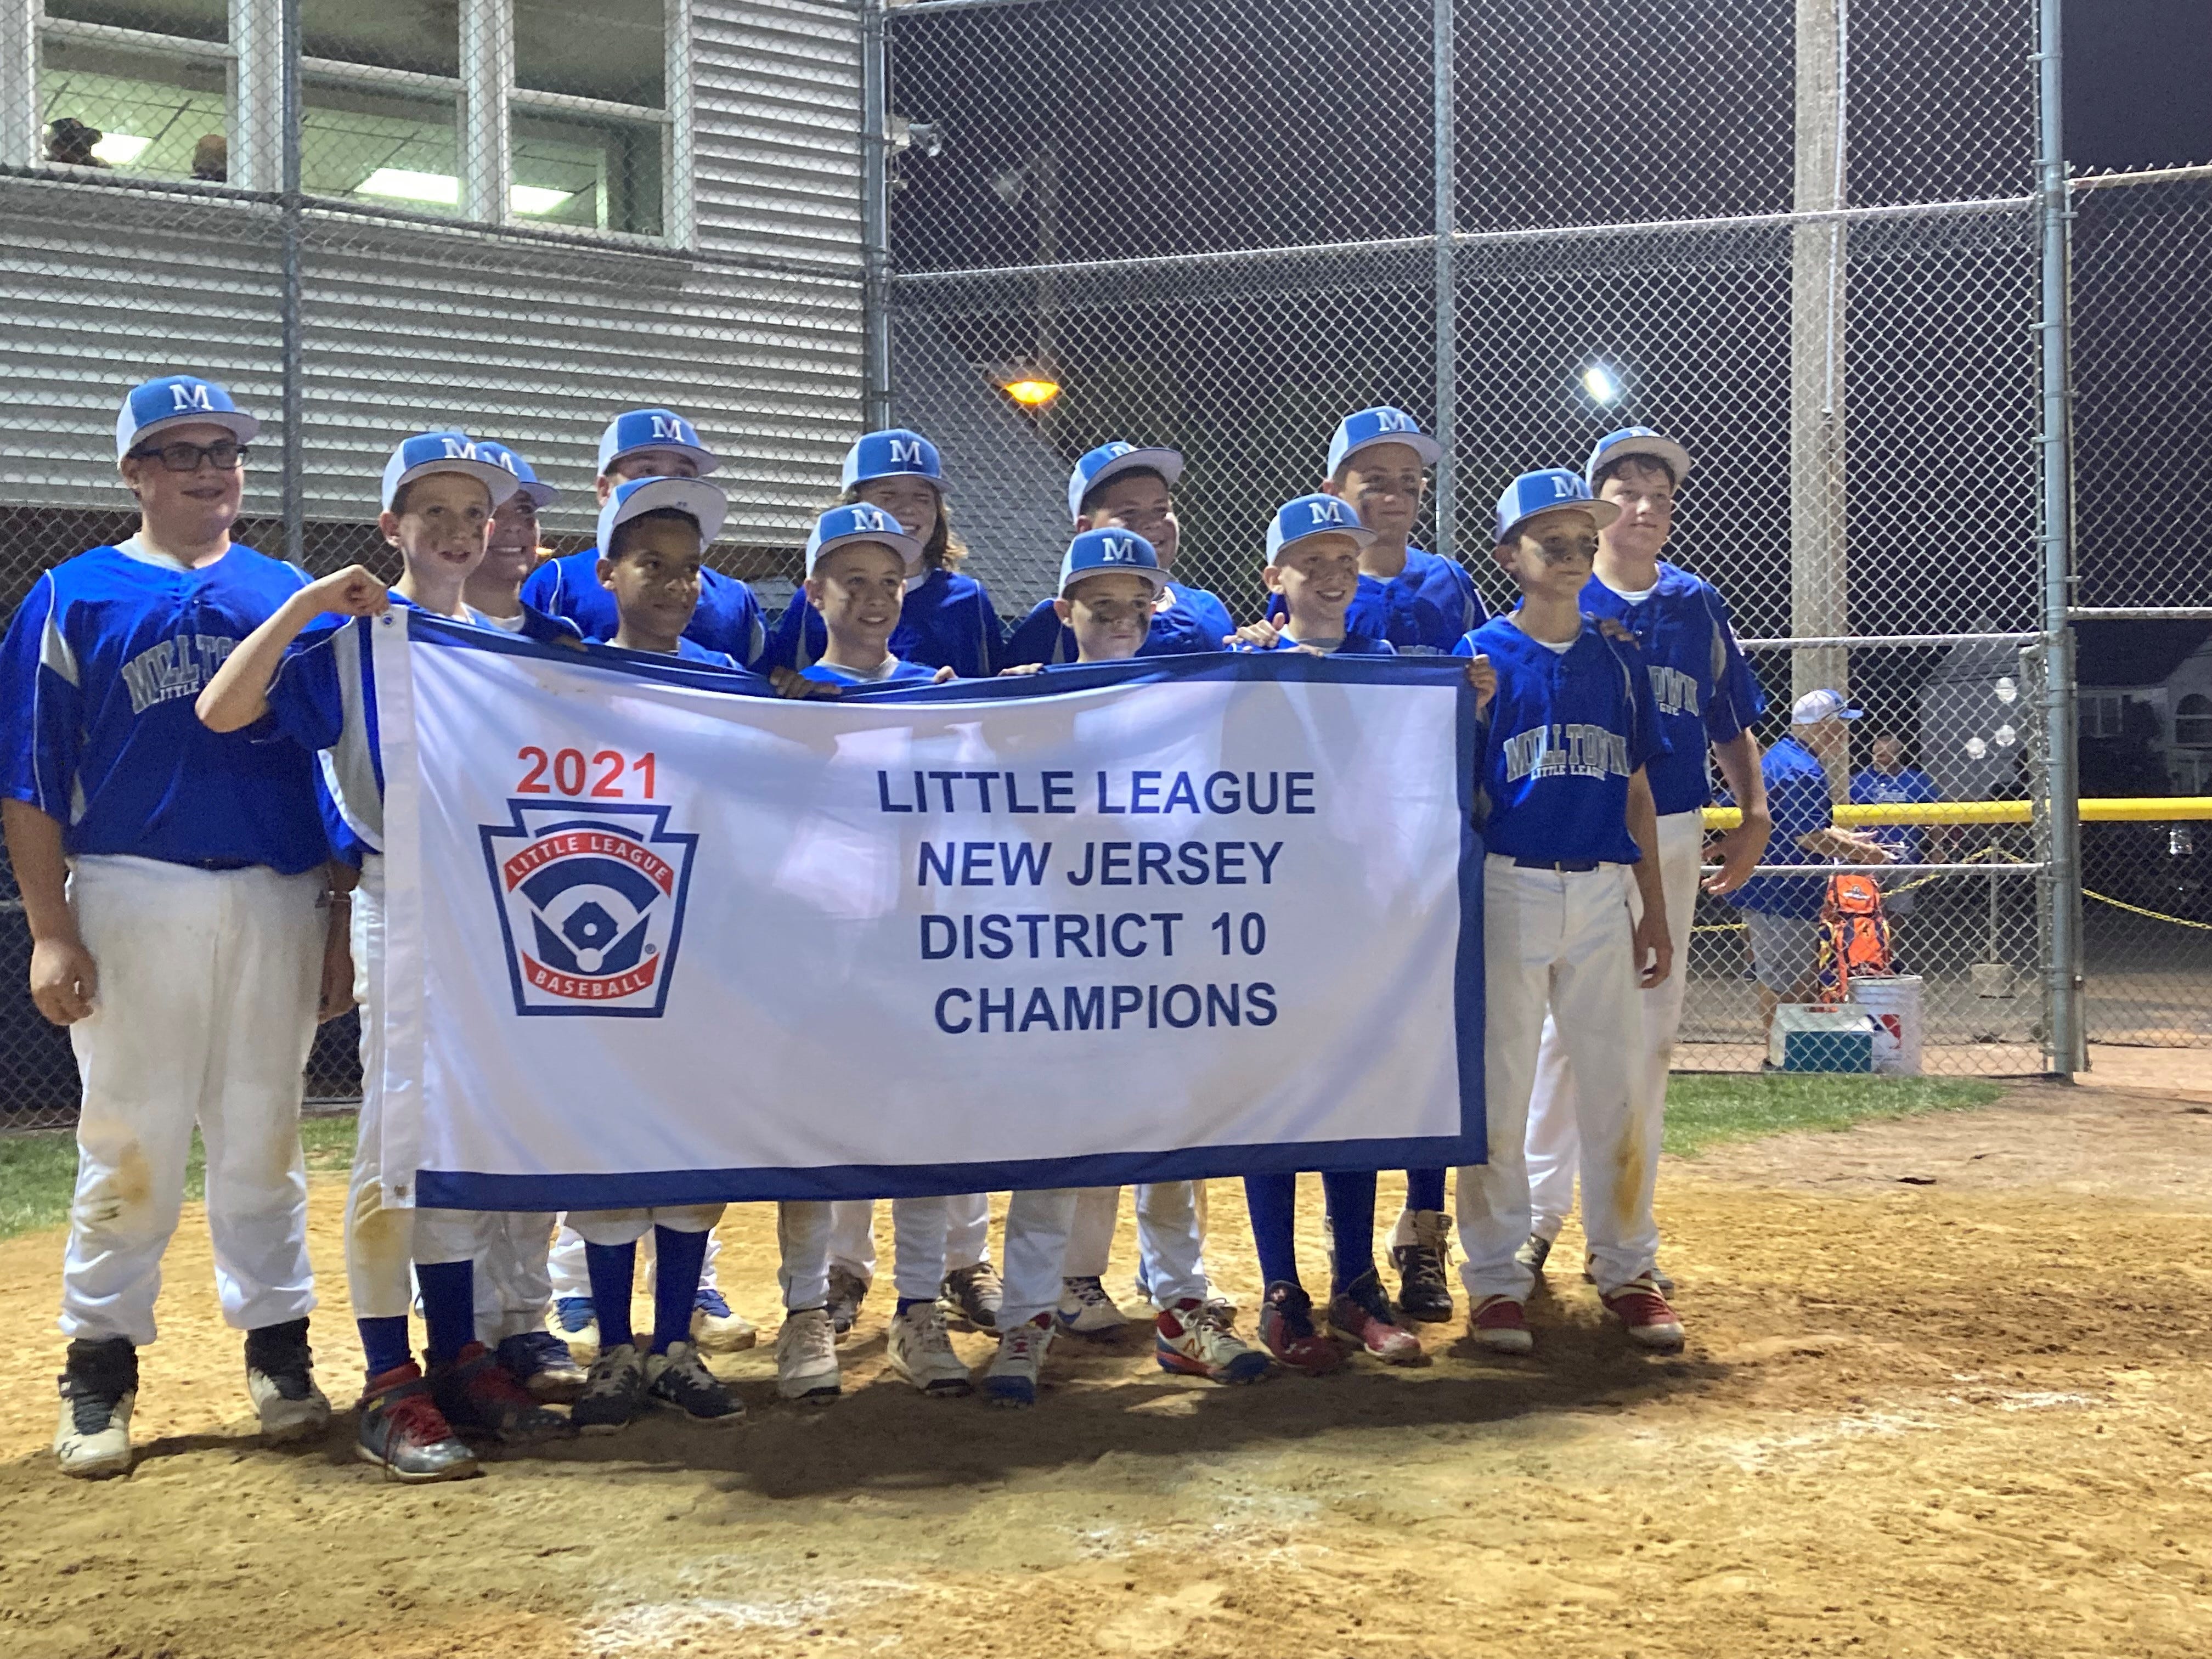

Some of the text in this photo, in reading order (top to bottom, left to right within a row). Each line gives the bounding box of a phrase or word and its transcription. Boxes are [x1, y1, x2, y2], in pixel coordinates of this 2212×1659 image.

[170, 384, 213, 410] M
[651, 416, 684, 442] M
[1376, 412, 1405, 431] M
[441, 438, 476, 460] M
[889, 440, 923, 465] M
[1551, 476, 1584, 499] M
[851, 509, 885, 531] M
[1308, 501, 1343, 524] M
[1102, 538, 1136, 562] M
[1503, 724, 1629, 783] MILLTOWN
[516, 746, 655, 799] 2021
[1531, 765, 1606, 781] LITTLE LEAGUE
[878, 771, 1316, 815] LITTLE LEAGUE
[509, 836, 669, 880] LITTLE LEAGUE
[918, 842, 1283, 886] NEW JERSEY
[921, 912, 1266, 960] DISTRICT 10
[535, 970, 646, 996] BASEBALL
[935, 983, 1278, 1034] CHAMPIONS
